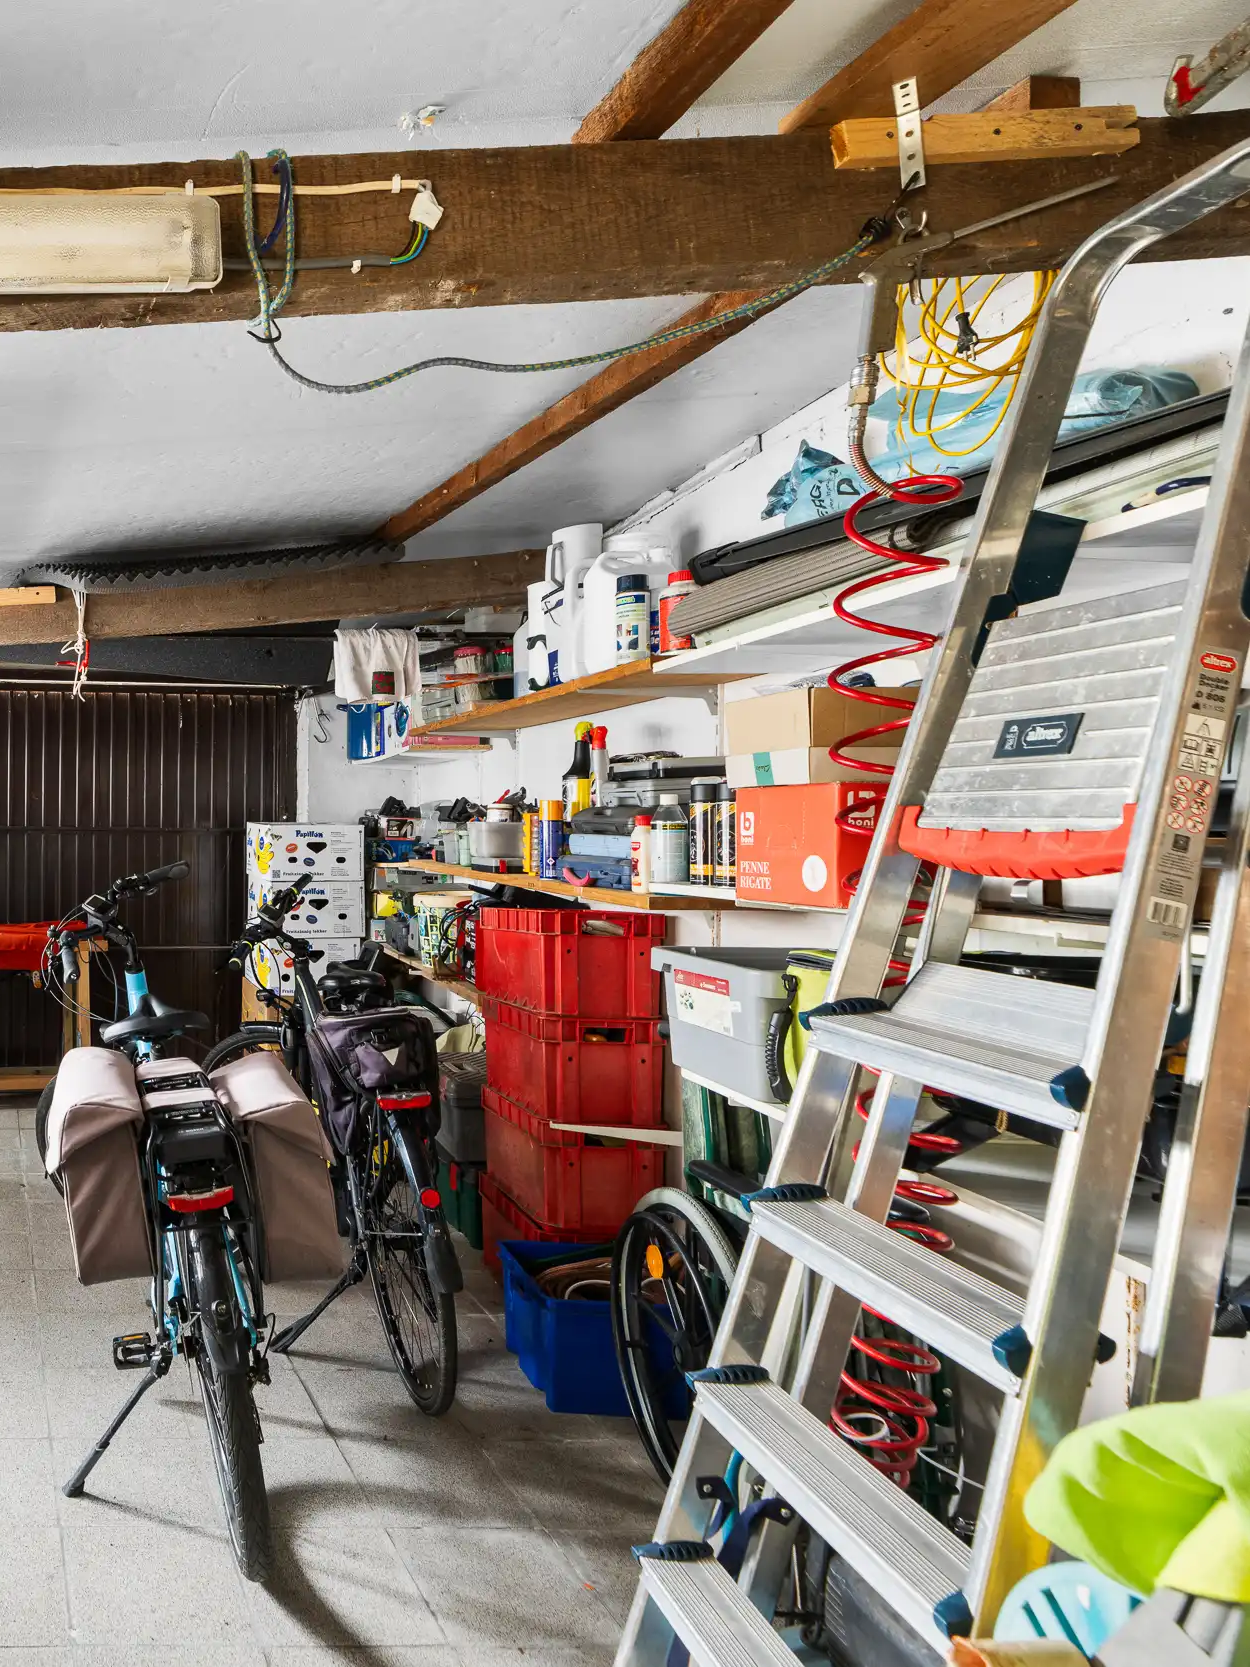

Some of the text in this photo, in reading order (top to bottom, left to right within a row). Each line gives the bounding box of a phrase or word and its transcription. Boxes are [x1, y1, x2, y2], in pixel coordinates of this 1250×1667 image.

[1203, 654, 1233, 668] altrex
[1026, 726, 1064, 741] altrex
[847, 817, 874, 827] boni
[295, 830, 324, 838] Papillon
[740, 860, 770, 874] PENNE
[740, 875, 772, 890] RIGATE
[301, 887, 325, 895] apillon
